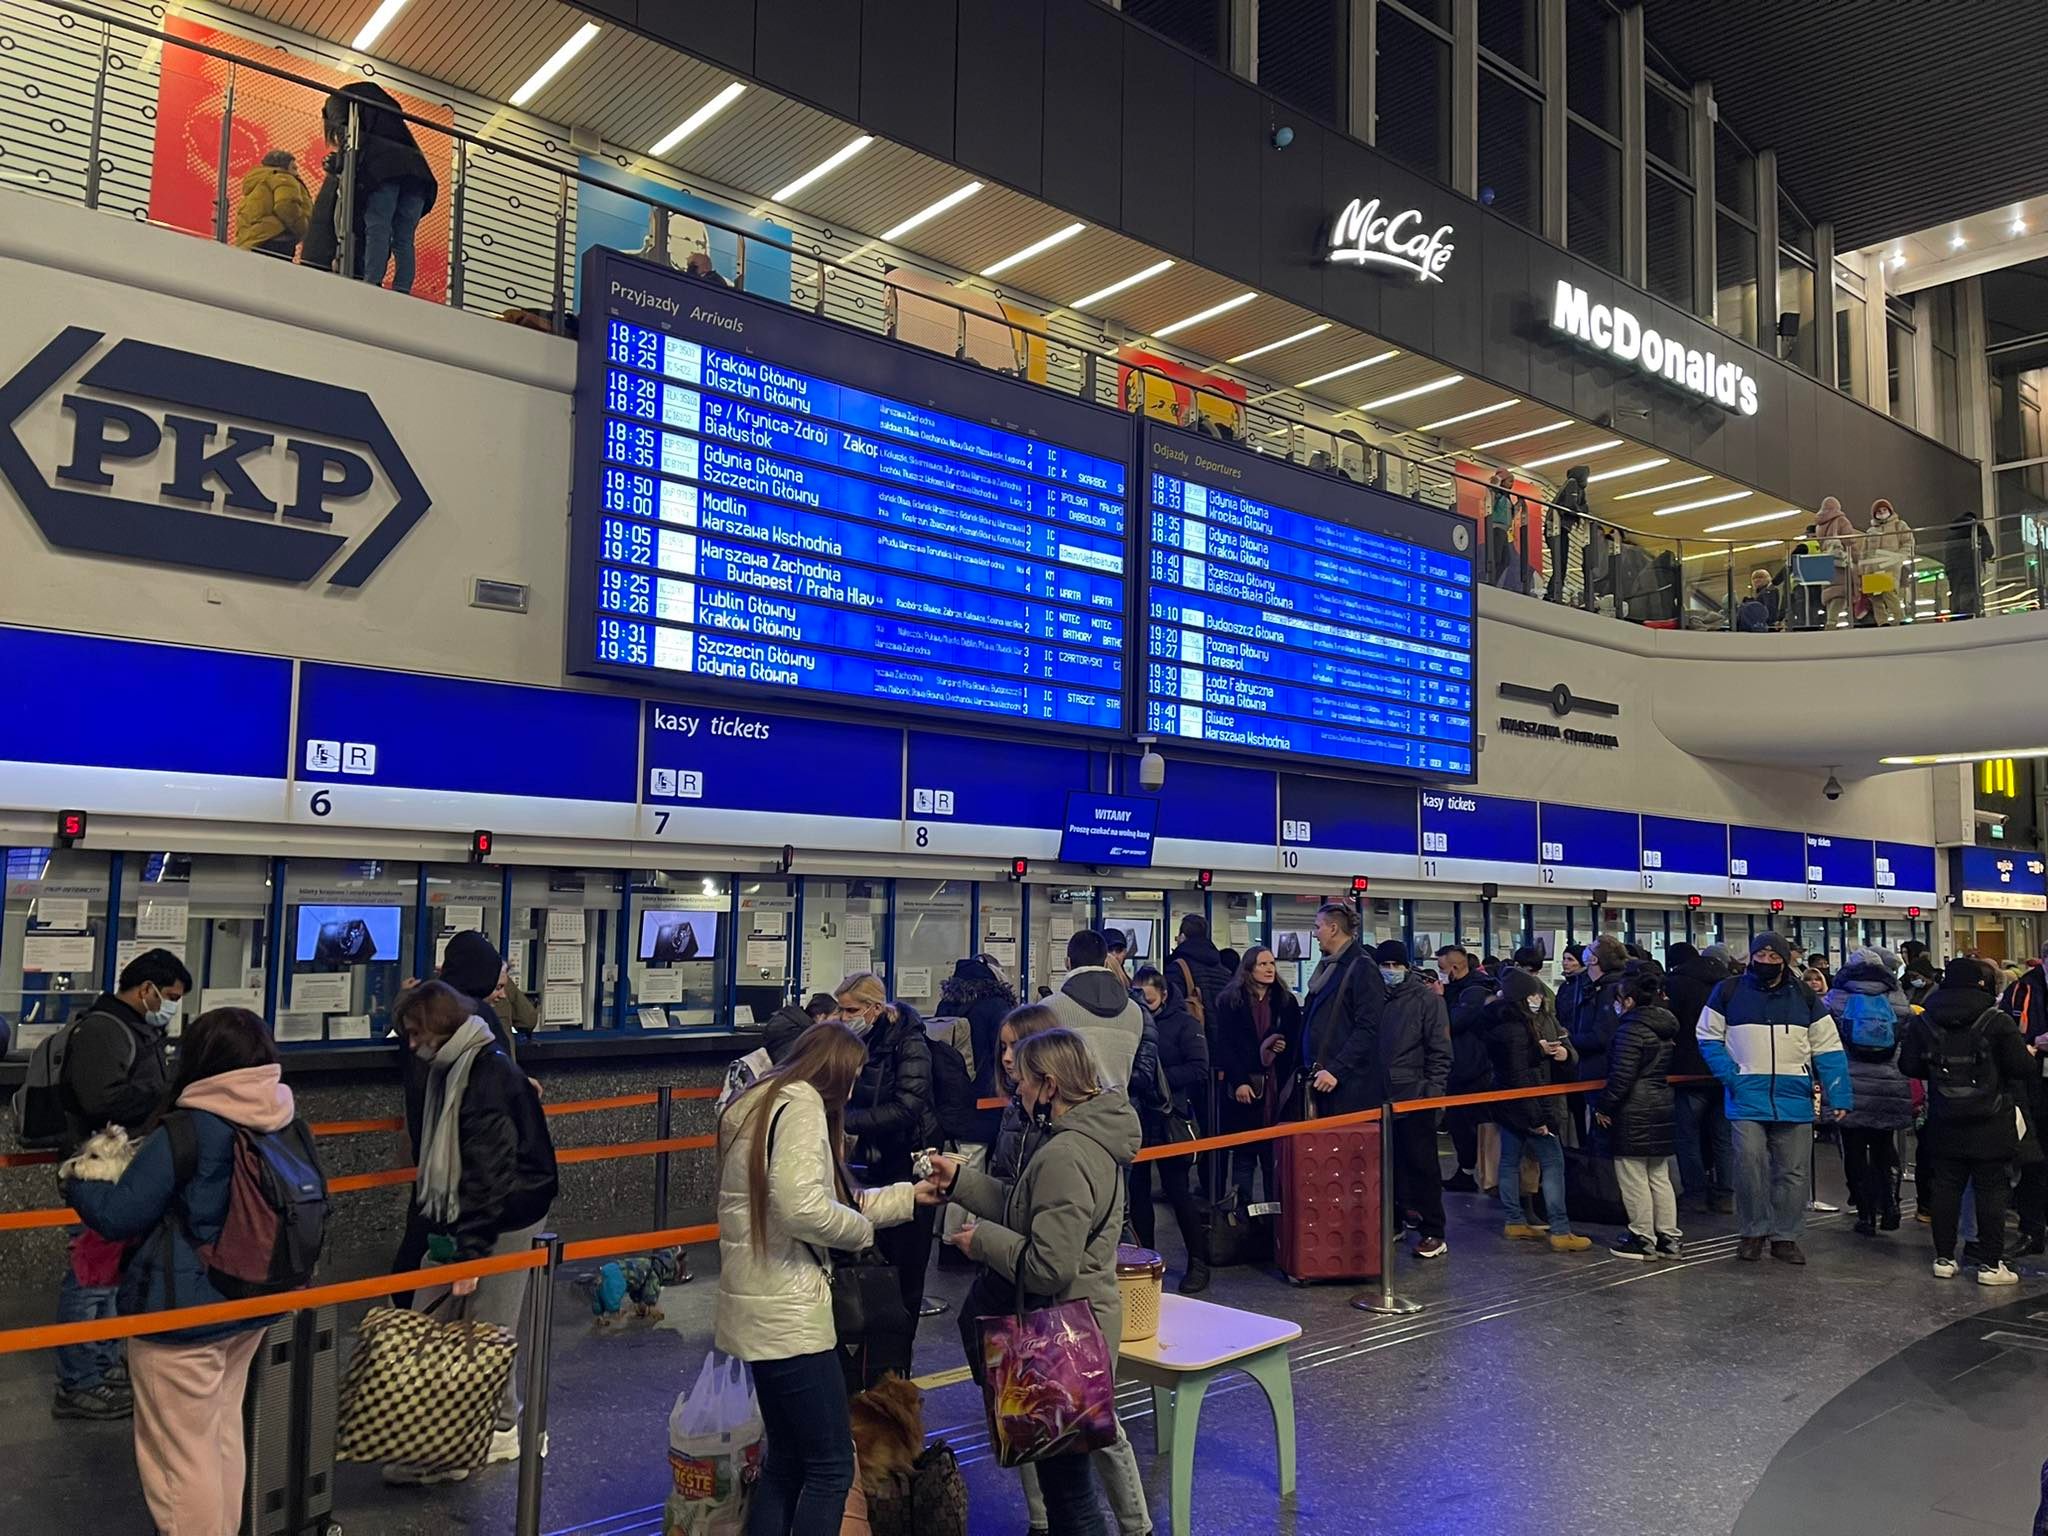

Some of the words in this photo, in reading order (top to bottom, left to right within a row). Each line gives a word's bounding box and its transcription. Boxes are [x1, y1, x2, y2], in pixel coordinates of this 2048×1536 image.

[1330, 198, 1456, 281] McCafé
[611, 280, 680, 317] Przyjazdy
[690, 305, 744, 333] Arrivals
[1553, 280, 1758, 415] McDonald's
[610, 342, 656, 370] 18:25
[705, 369, 759, 400] Olsztyn
[763, 385, 810, 414] Główny
[1027, 460, 1032, 470] 4
[1048, 465, 1056, 477] IC
[611, 322, 657, 351] 18:23
[706, 350, 754, 379] Kraków
[759, 364, 806, 399] Główny
[1027, 443, 1032, 455] 2
[1048, 449, 1056, 461] IC
[608, 391, 654, 418] 18:29
[705, 416, 772, 449] Białystok
[1026, 500, 1031, 511] 3
[1047, 505, 1055, 517] IC
[609, 371, 655, 398] 18:28
[736, 405, 828, 446] Krynica-Zdrój
[1027, 484, 1030, 495] 1
[1047, 489, 1055, 501] IC
[56, 394, 374, 524] PKP
[1153, 442, 1189, 464] Odjazdy
[1195, 455, 1242, 479] Departures
[608, 420, 654, 447] 18:35
[704, 444, 751, 472] Gdynia
[755, 456, 803, 483] Główna
[1026, 524, 1031, 535] 3
[1046, 529, 1055, 540] IC
[1153, 474, 1180, 493] 18:30
[1209, 491, 1237, 512] Gdynia
[1240, 499, 1268, 519] Główna
[607, 441, 653, 466] 18:35
[703, 464, 768, 494] Szczecin
[771, 479, 819, 507] Główny
[1025, 540, 1030, 551] 2
[1046, 545, 1054, 557] IC
[1153, 489, 1180, 510] 18:33
[1209, 504, 1241, 526] Wrocław
[1244, 514, 1272, 535] Główny
[606, 470, 652, 496] 18:50
[702, 491, 747, 517] Modlin
[1025, 565, 1030, 576] 4
[1152, 512, 1179, 531] 18:35
[1209, 526, 1236, 547] Gdynia
[1239, 534, 1268, 554] Główna
[605, 490, 652, 516] 19:00
[702, 511, 768, 541] Warszawa
[772, 524, 842, 555] Wschodnia
[1025, 582, 1030, 592] 4
[1046, 585, 1054, 597] IC
[1059, 587, 1081, 601] WARTA
[1092, 594, 1112, 607] WARTA
[1152, 527, 1179, 546] 18:40
[1209, 541, 1237, 560] Kraków
[1240, 548, 1269, 570] Główny
[604, 519, 650, 545] 19:05
[701, 540, 768, 568] Warszawa
[771, 553, 841, 582] Zachodnia
[1025, 606, 1028, 616] 1
[1045, 609, 1053, 621] IC
[1151, 549, 1179, 568] 18:40
[1246, 571, 1274, 592] Główny
[1151, 565, 1178, 584] 18:50
[1208, 578, 1262, 602] Bielsko-Biała
[1265, 590, 1292, 608] Główna
[604, 540, 650, 565] 19:22
[726, 563, 792, 593] Budapest
[806, 578, 843, 602] Praha
[847, 586, 874, 607] Hlav
[1024, 622, 1029, 633] 2
[1045, 626, 1053, 637] IC
[601, 590, 648, 614] 19:26
[699, 606, 749, 631] Kraków
[752, 615, 800, 640] Główny
[1023, 662, 1028, 673] 2
[1044, 666, 1052, 677] IC
[602, 570, 649, 594] 19:25
[699, 587, 744, 611] Lublin
[747, 594, 796, 621] Główny
[1024, 646, 1029, 657] 3
[1044, 650, 1053, 661] IC
[1150, 602, 1178, 620] 19:10
[1207, 614, 1253, 637] Bydgoszcz
[1255, 624, 1283, 642] Główna
[600, 620, 646, 643] 19:31
[698, 636, 764, 661] Szczecin
[767, 646, 815, 670] Główny
[1024, 687, 1027, 698] 1
[1044, 690, 1052, 701] IC
[1150, 625, 1177, 643] 19:20
[1239, 642, 1268, 661] Główny
[1150, 640, 1177, 658] 19:27
[1206, 651, 1243, 670] Terespol
[599, 640, 646, 663] 19:35
[697, 655, 746, 679] Gdynia
[750, 662, 798, 684] Główna
[1022, 703, 1028, 714] 3
[1043, 706, 1052, 717] IC
[1149, 663, 1176, 680] 19:30
[1229, 677, 1273, 698] Fabryczna
[1149, 678, 1176, 696] 19:32
[1206, 689, 1234, 706] Gdynia
[1237, 693, 1266, 710] Główna
[654, 708, 700, 737] kasy
[710, 716, 770, 739] tickets
[1148, 701, 1176, 718] 19:40
[1205, 710, 1234, 726] Gliwice
[1500, 717, 1561, 738] WARSZAWA
[1148, 717, 1174, 734] 19:41
[1205, 726, 1245, 743] Warszawa
[1247, 731, 1289, 749] Wschodnia
[351, 747, 367, 766] R
[683, 774, 696, 791] R
[310, 790, 331, 817] 6
[938, 794, 950, 810] R
[1094, 808, 1132, 822] WITAMY
[1423, 793, 1444, 811] kasy
[1448, 797, 1476, 812] tickets
[65, 816, 80, 834] 5
[654, 812, 670, 835] 7
[916, 826, 928, 848] 8
[1069, 824, 1090, 836] Proszę
[1110, 828, 1118, 836] na
[479, 835, 489, 851] 6
[1282, 851, 1298, 868] 10
[1202, 872, 1209, 882] 9
[1354, 878, 1366, 889] 10
[1424, 861, 1436, 877] 11
[1542, 869, 1554, 883] 12
[1643, 875, 1654, 889] 13
[1731, 882, 1741, 895] 14
[1809, 888, 1818, 900] 15
